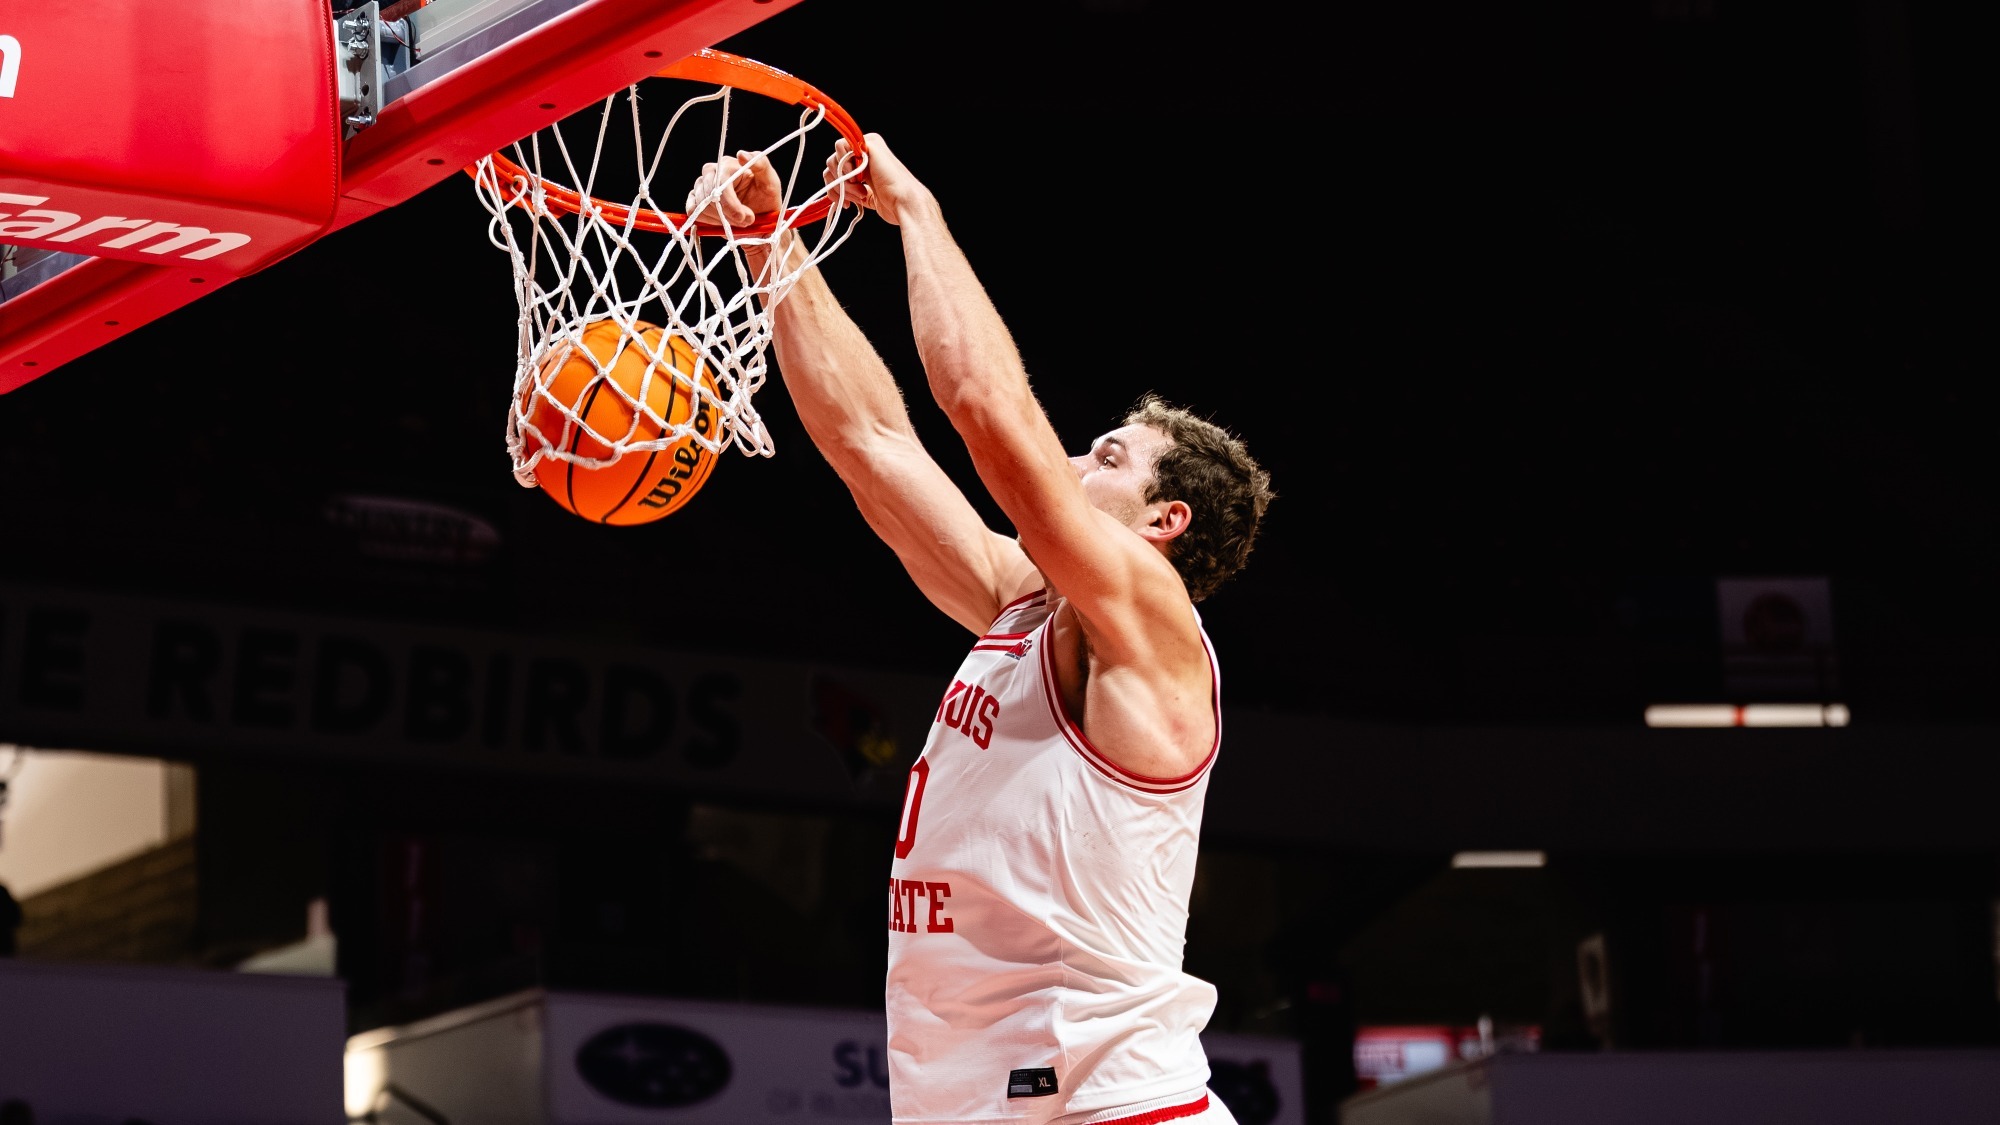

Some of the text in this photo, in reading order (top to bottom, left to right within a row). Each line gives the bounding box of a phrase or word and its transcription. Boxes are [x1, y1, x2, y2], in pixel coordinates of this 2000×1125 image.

[0, 604, 742, 769] E REDBIRDS
[1038, 1077, 1051, 1088] XL
